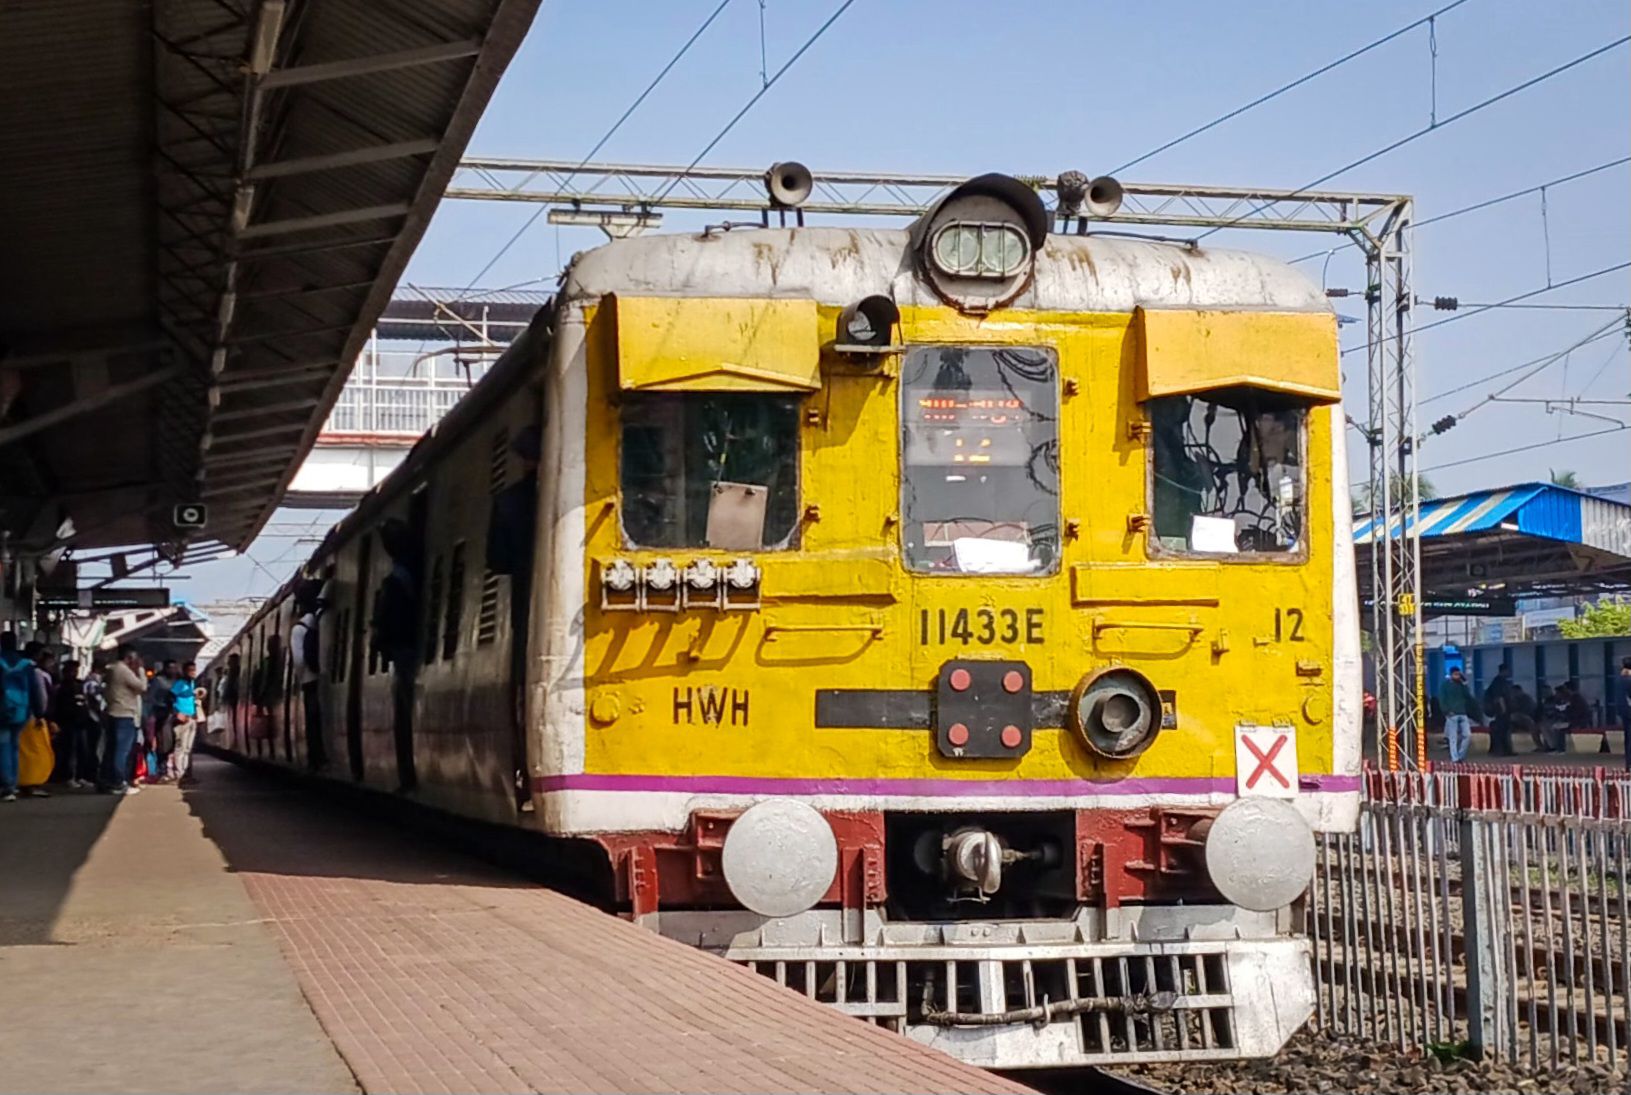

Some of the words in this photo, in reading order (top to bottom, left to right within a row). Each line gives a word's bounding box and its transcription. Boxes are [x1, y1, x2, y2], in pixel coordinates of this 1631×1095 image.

[921, 607, 1046, 647] 11433E
[1273, 607, 1306, 644] 12
[672, 686, 750, 727] HWH
